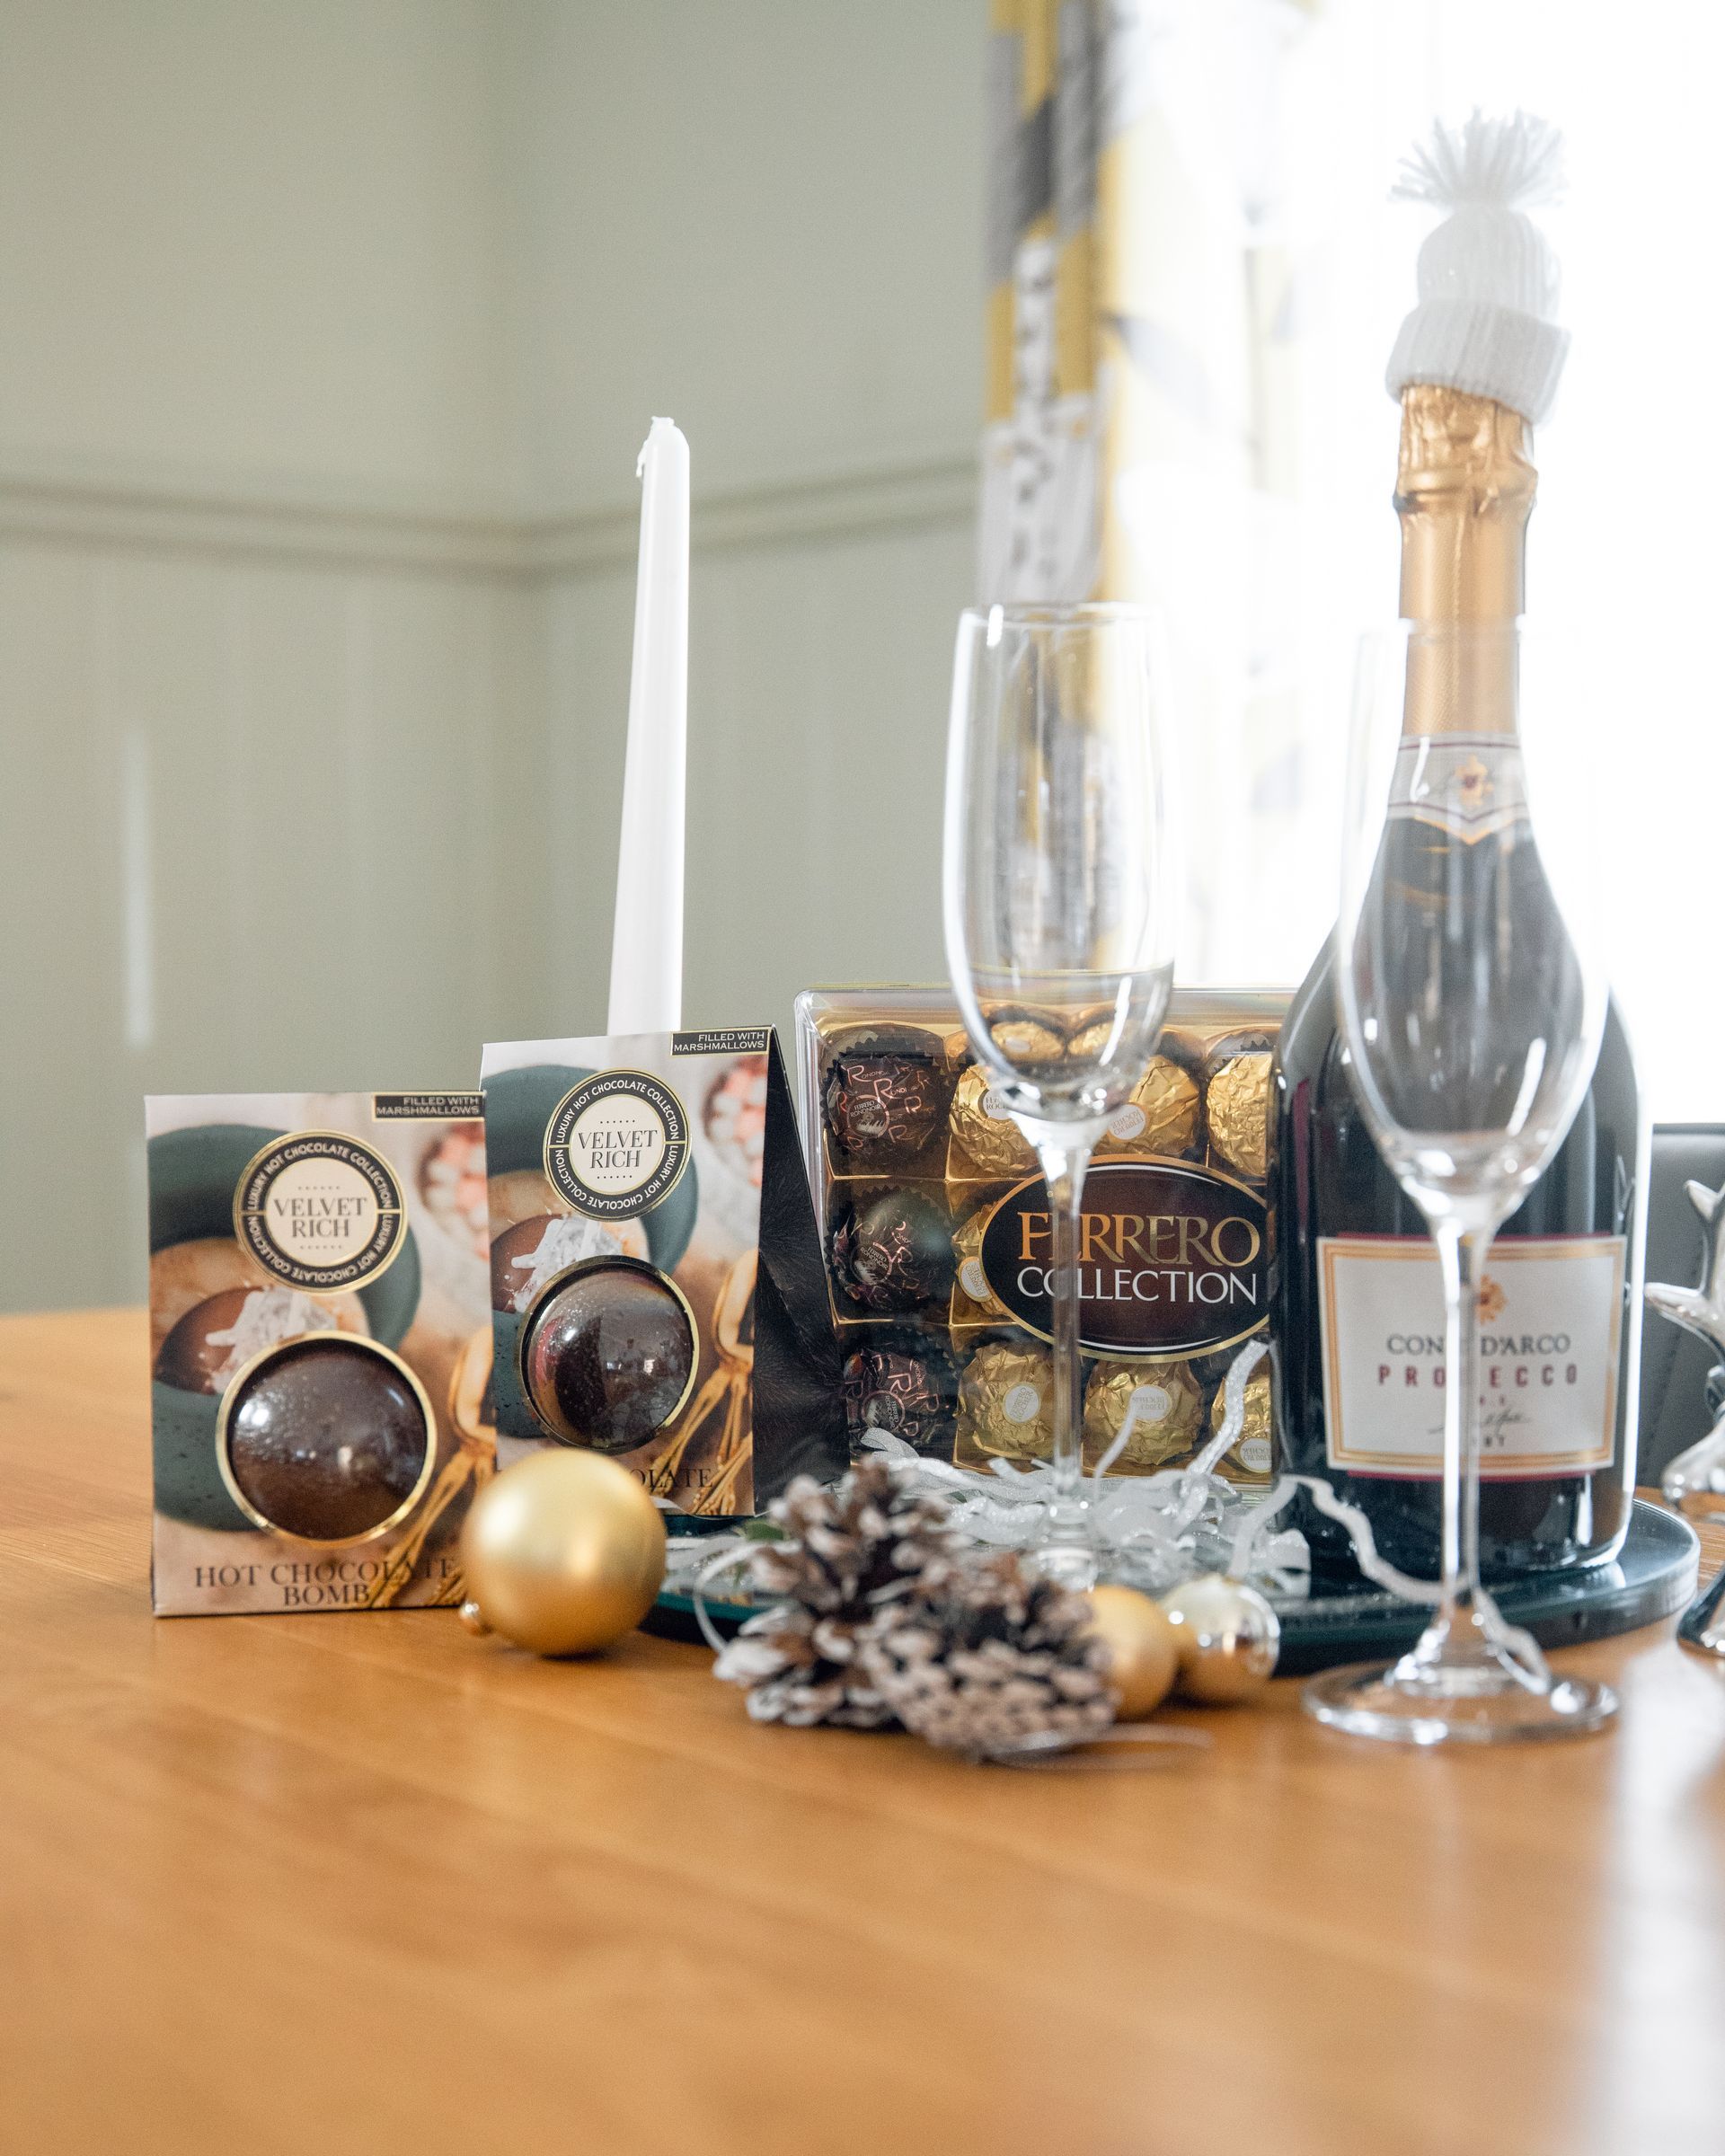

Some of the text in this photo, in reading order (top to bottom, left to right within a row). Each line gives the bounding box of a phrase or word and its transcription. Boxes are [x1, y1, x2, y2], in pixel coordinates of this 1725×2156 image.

[674, 1040, 765, 1052] MARSHMALLOWS
[698, 1032, 765, 1042] FILLED WITH
[376, 1106, 480, 1115] MARSHMALLOWS
[403, 1096, 480, 1105] FILLED WITH
[556, 1080, 679, 1144] LUXURY HOT CHOCOLATE COLLECTION
[578, 1129, 658, 1150] VELVET
[589, 1150, 641, 1169] RICH
[247, 1143, 394, 1210] LUXURY HOT CHOCOLATE COLLECTION
[555, 1144, 679, 1210] LUXURY HOT CHOCOLATE COLLECTION
[273, 1197, 367, 1217] VELVET
[292, 1218, 349, 1239] RICH
[248, 1215, 394, 1283] LUXURY HOT CHOCOLATE COLLECTION
[1386, 1333, 1571, 1356] CON D'ARCO
[1378, 1363, 1578, 1388] PROECCO
[195, 1558, 456, 1587] HOT CHOCOLATE
[284, 1584, 371, 1606] BOMB
